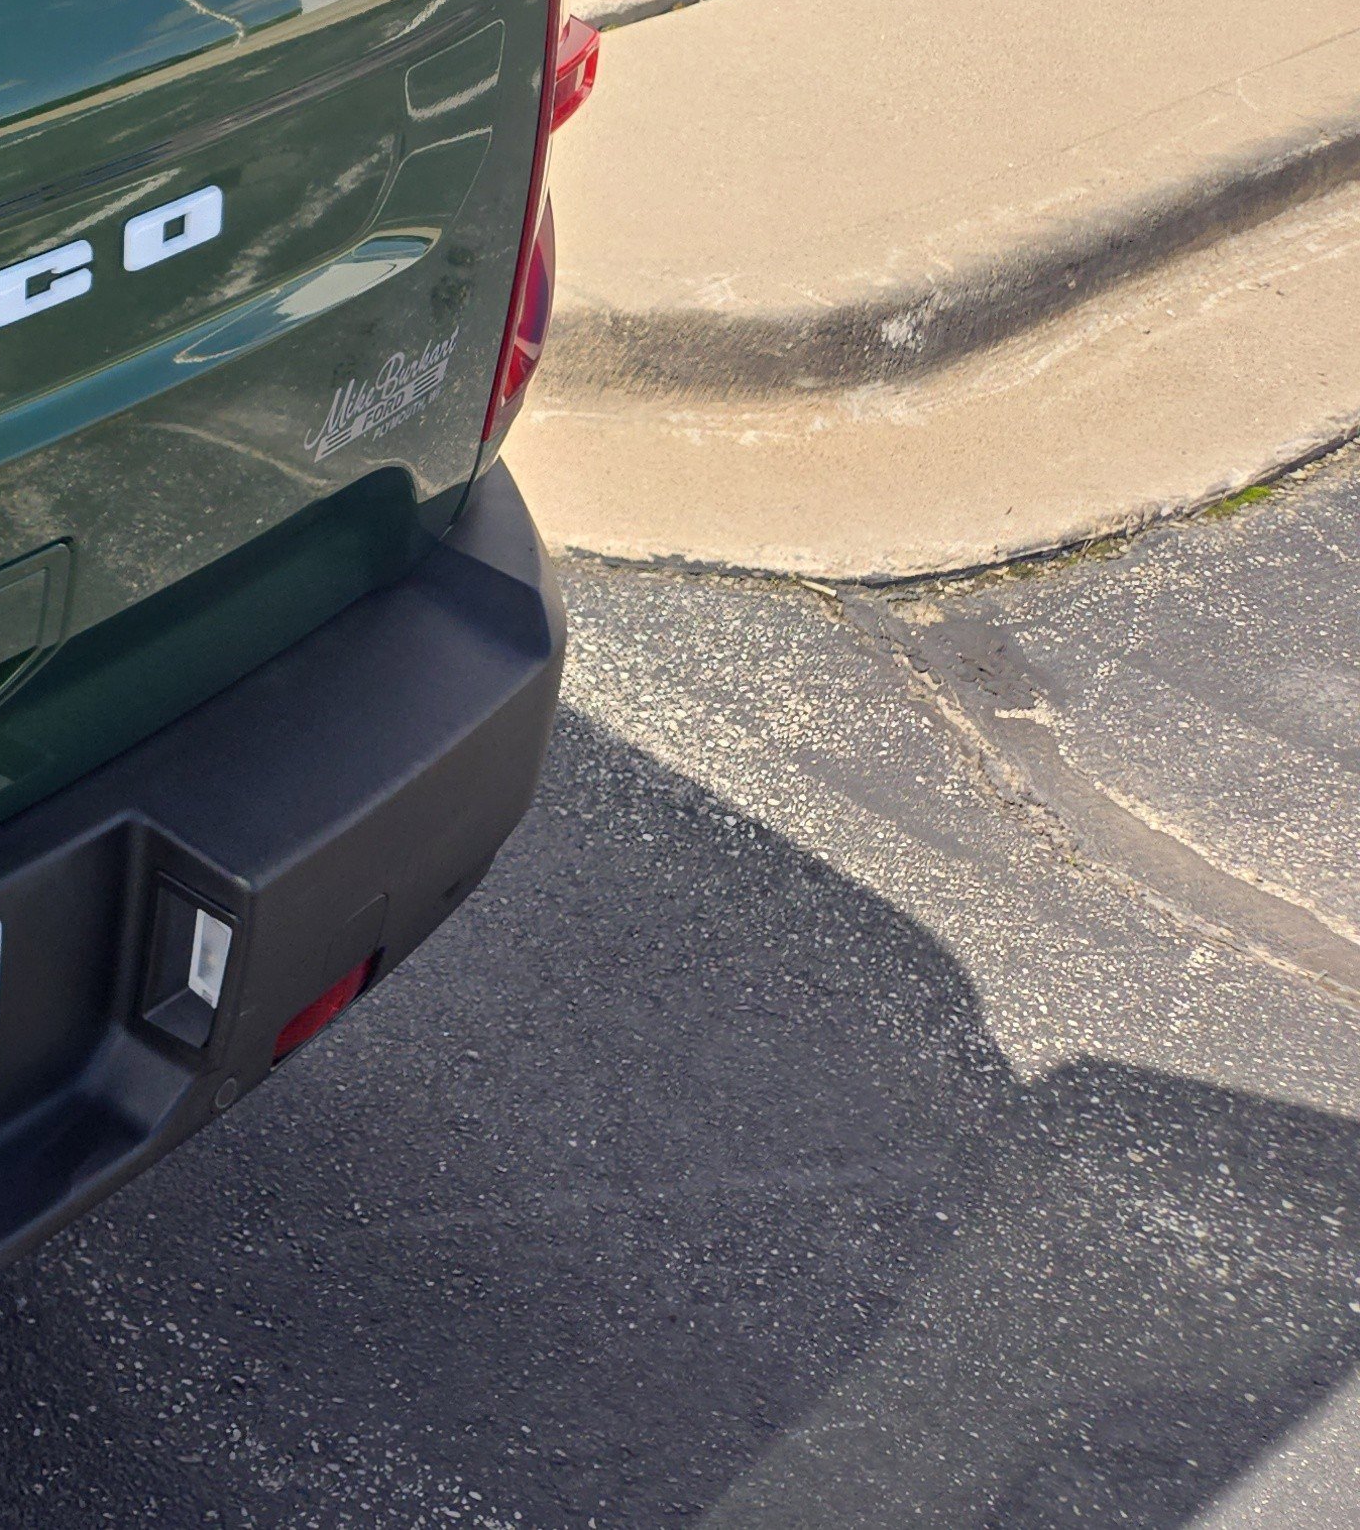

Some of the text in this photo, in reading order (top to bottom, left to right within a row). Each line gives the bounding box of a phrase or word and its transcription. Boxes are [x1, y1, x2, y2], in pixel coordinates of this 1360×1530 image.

[303, 325, 460, 451] Mike Burkart
[362, 392, 406, 428] FORD
